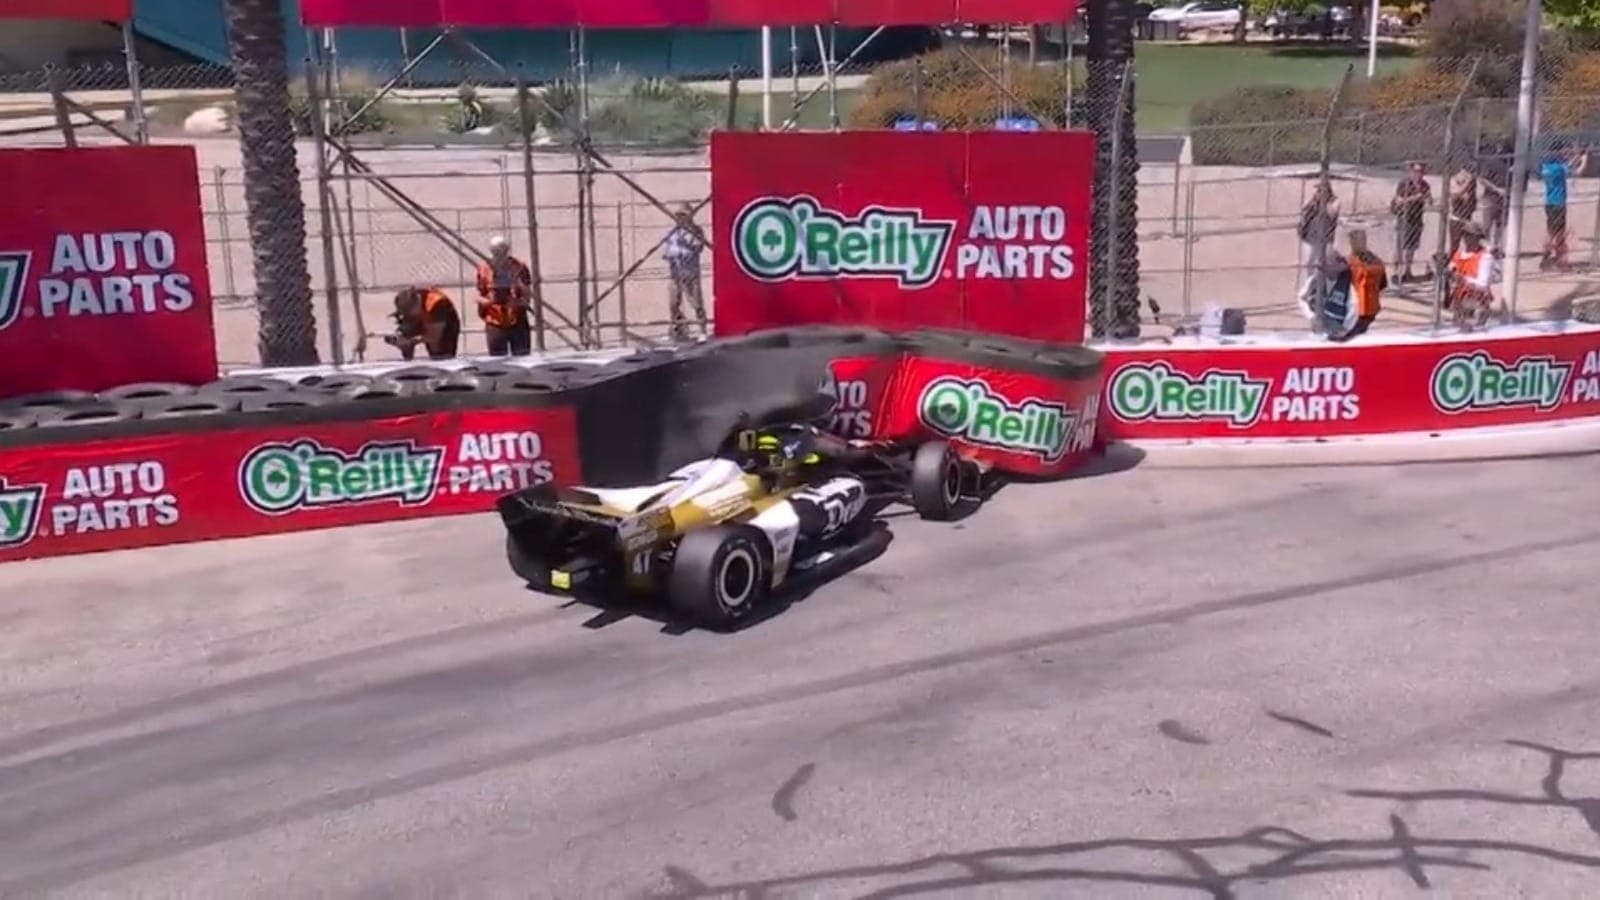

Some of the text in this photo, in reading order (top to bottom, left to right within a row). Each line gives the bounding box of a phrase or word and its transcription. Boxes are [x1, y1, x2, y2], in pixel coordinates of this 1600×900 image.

[741, 203, 940, 279] O'Reilly
[968, 205, 1066, 240] AUTO
[51, 230, 176, 273] AUTO
[956, 244, 1074, 279] PARTS
[38, 274, 194, 318] PARTS
[1111, 365, 1264, 424] O'Reilly
[1281, 366, 1355, 394] AUTO
[1434, 354, 1566, 410] O'Reilly
[922, 381, 1072, 456] O'Reilly
[1271, 395, 1361, 420] PARTS
[458, 430, 541, 462] AUTO
[63, 460, 165, 499] AUTO
[245, 443, 436, 508] O'Reilly
[449, 460, 553, 495] PARTS
[51, 494, 180, 537] PARTS
